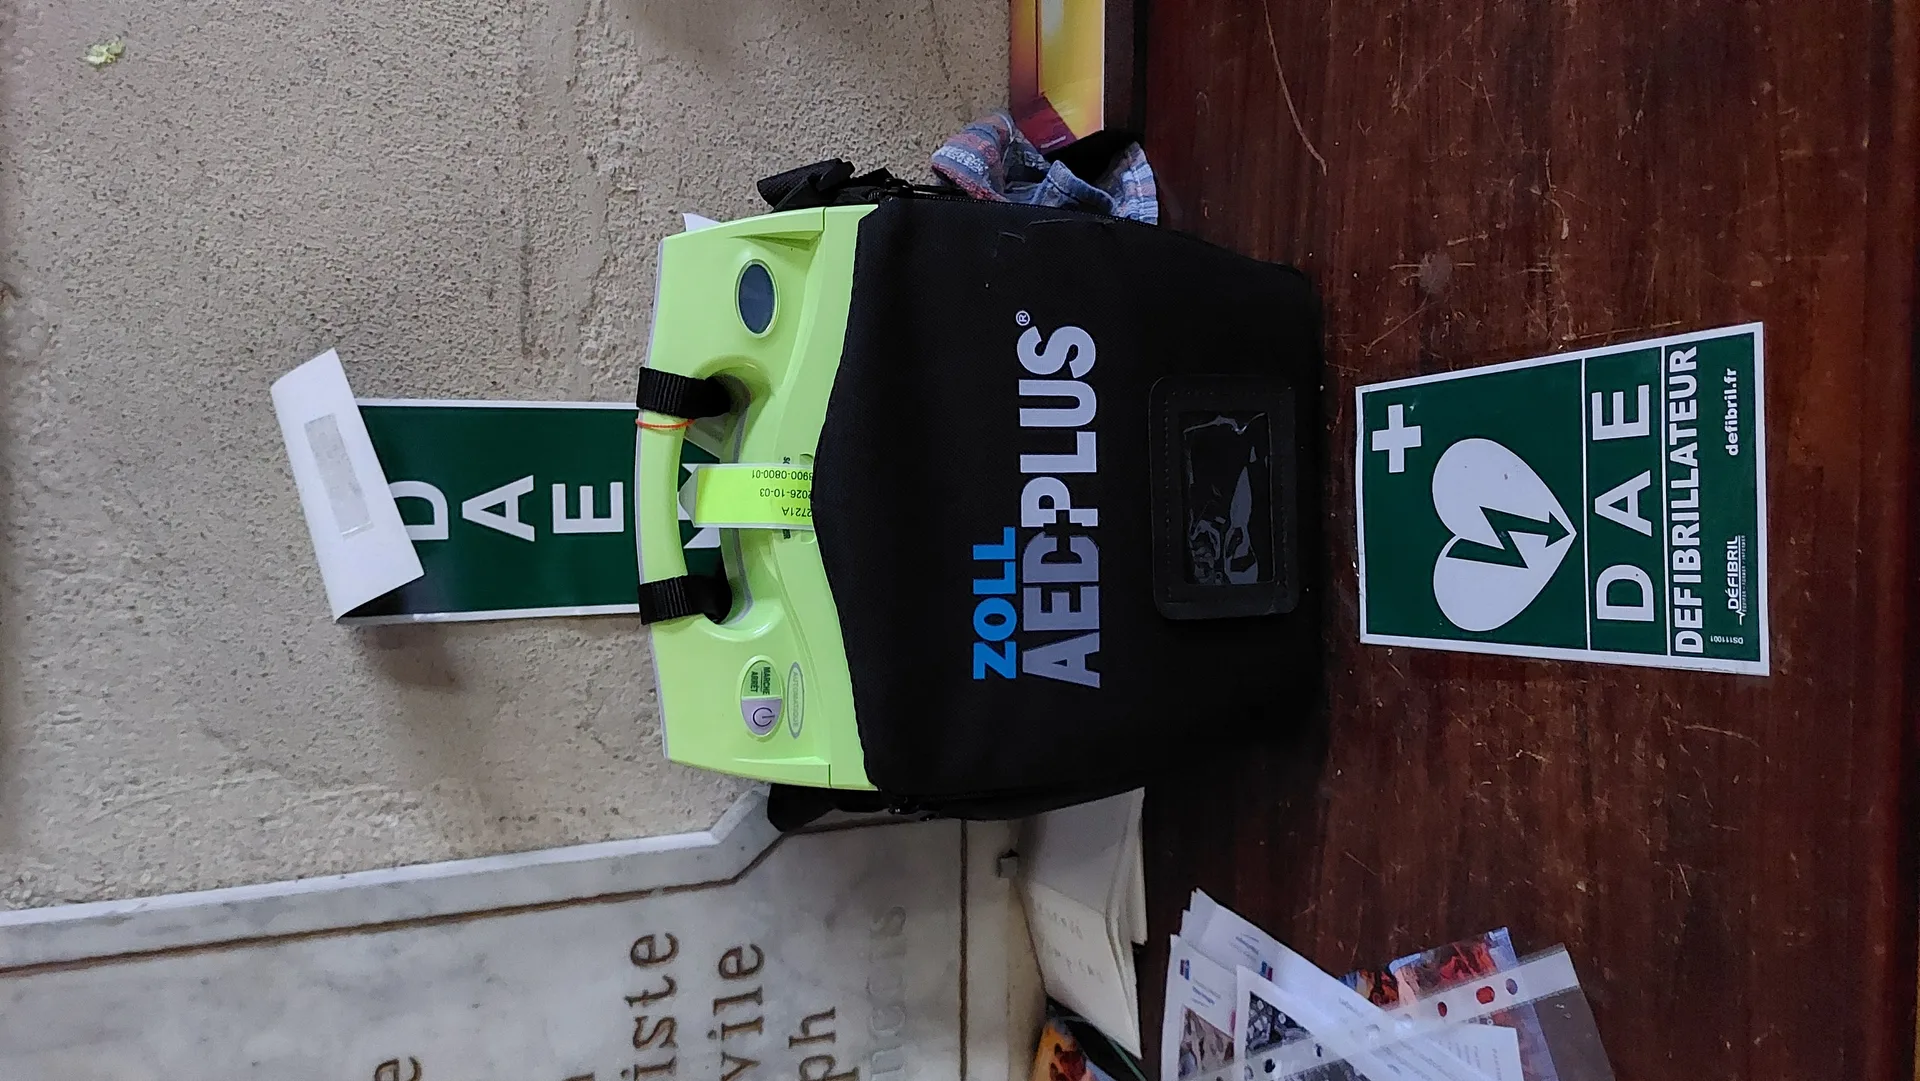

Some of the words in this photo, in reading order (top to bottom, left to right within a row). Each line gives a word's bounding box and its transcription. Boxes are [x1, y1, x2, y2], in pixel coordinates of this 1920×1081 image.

[1724, 368, 1739, 456] defibril.fr
[1590, 384, 1655, 622] DAE
[1669, 346, 1703, 653] DEFIBRILLATEUR
[973, 526, 1017, 680] ZOLL
[1725, 535, 1739, 610] DÉFIBRIL
[763, 667, 771, 695] MARCHE
